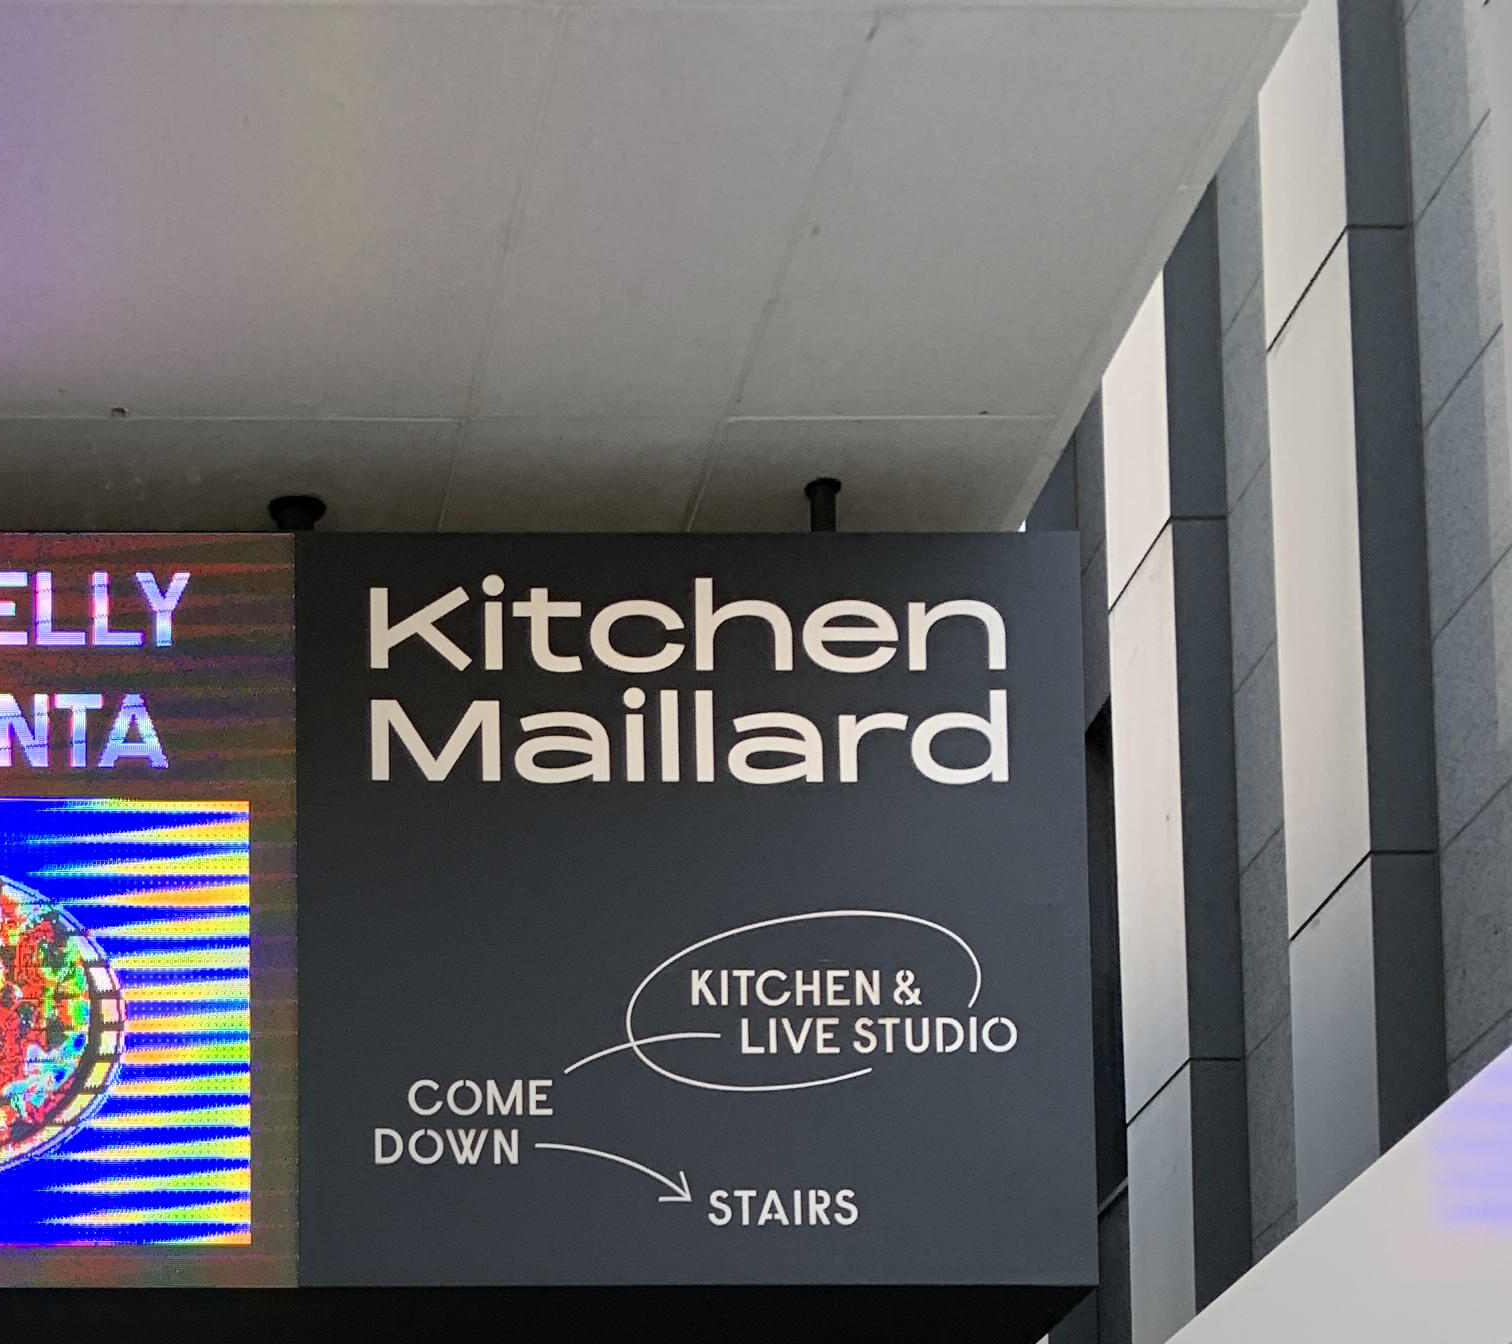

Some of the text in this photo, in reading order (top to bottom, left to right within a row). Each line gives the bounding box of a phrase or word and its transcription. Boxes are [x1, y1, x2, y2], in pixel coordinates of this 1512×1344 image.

[369, 574, 1007, 674] Kitchen
[370, 687, 1010, 785] Maillard
[691, 969, 922, 1007] KITCHEN &
[741, 1016, 1018, 1054] LIVE STUDIO
[407, 1079, 554, 1116] COME
[374, 1127, 519, 1165] DOWN
[708, 1189, 859, 1226] STAIRS
